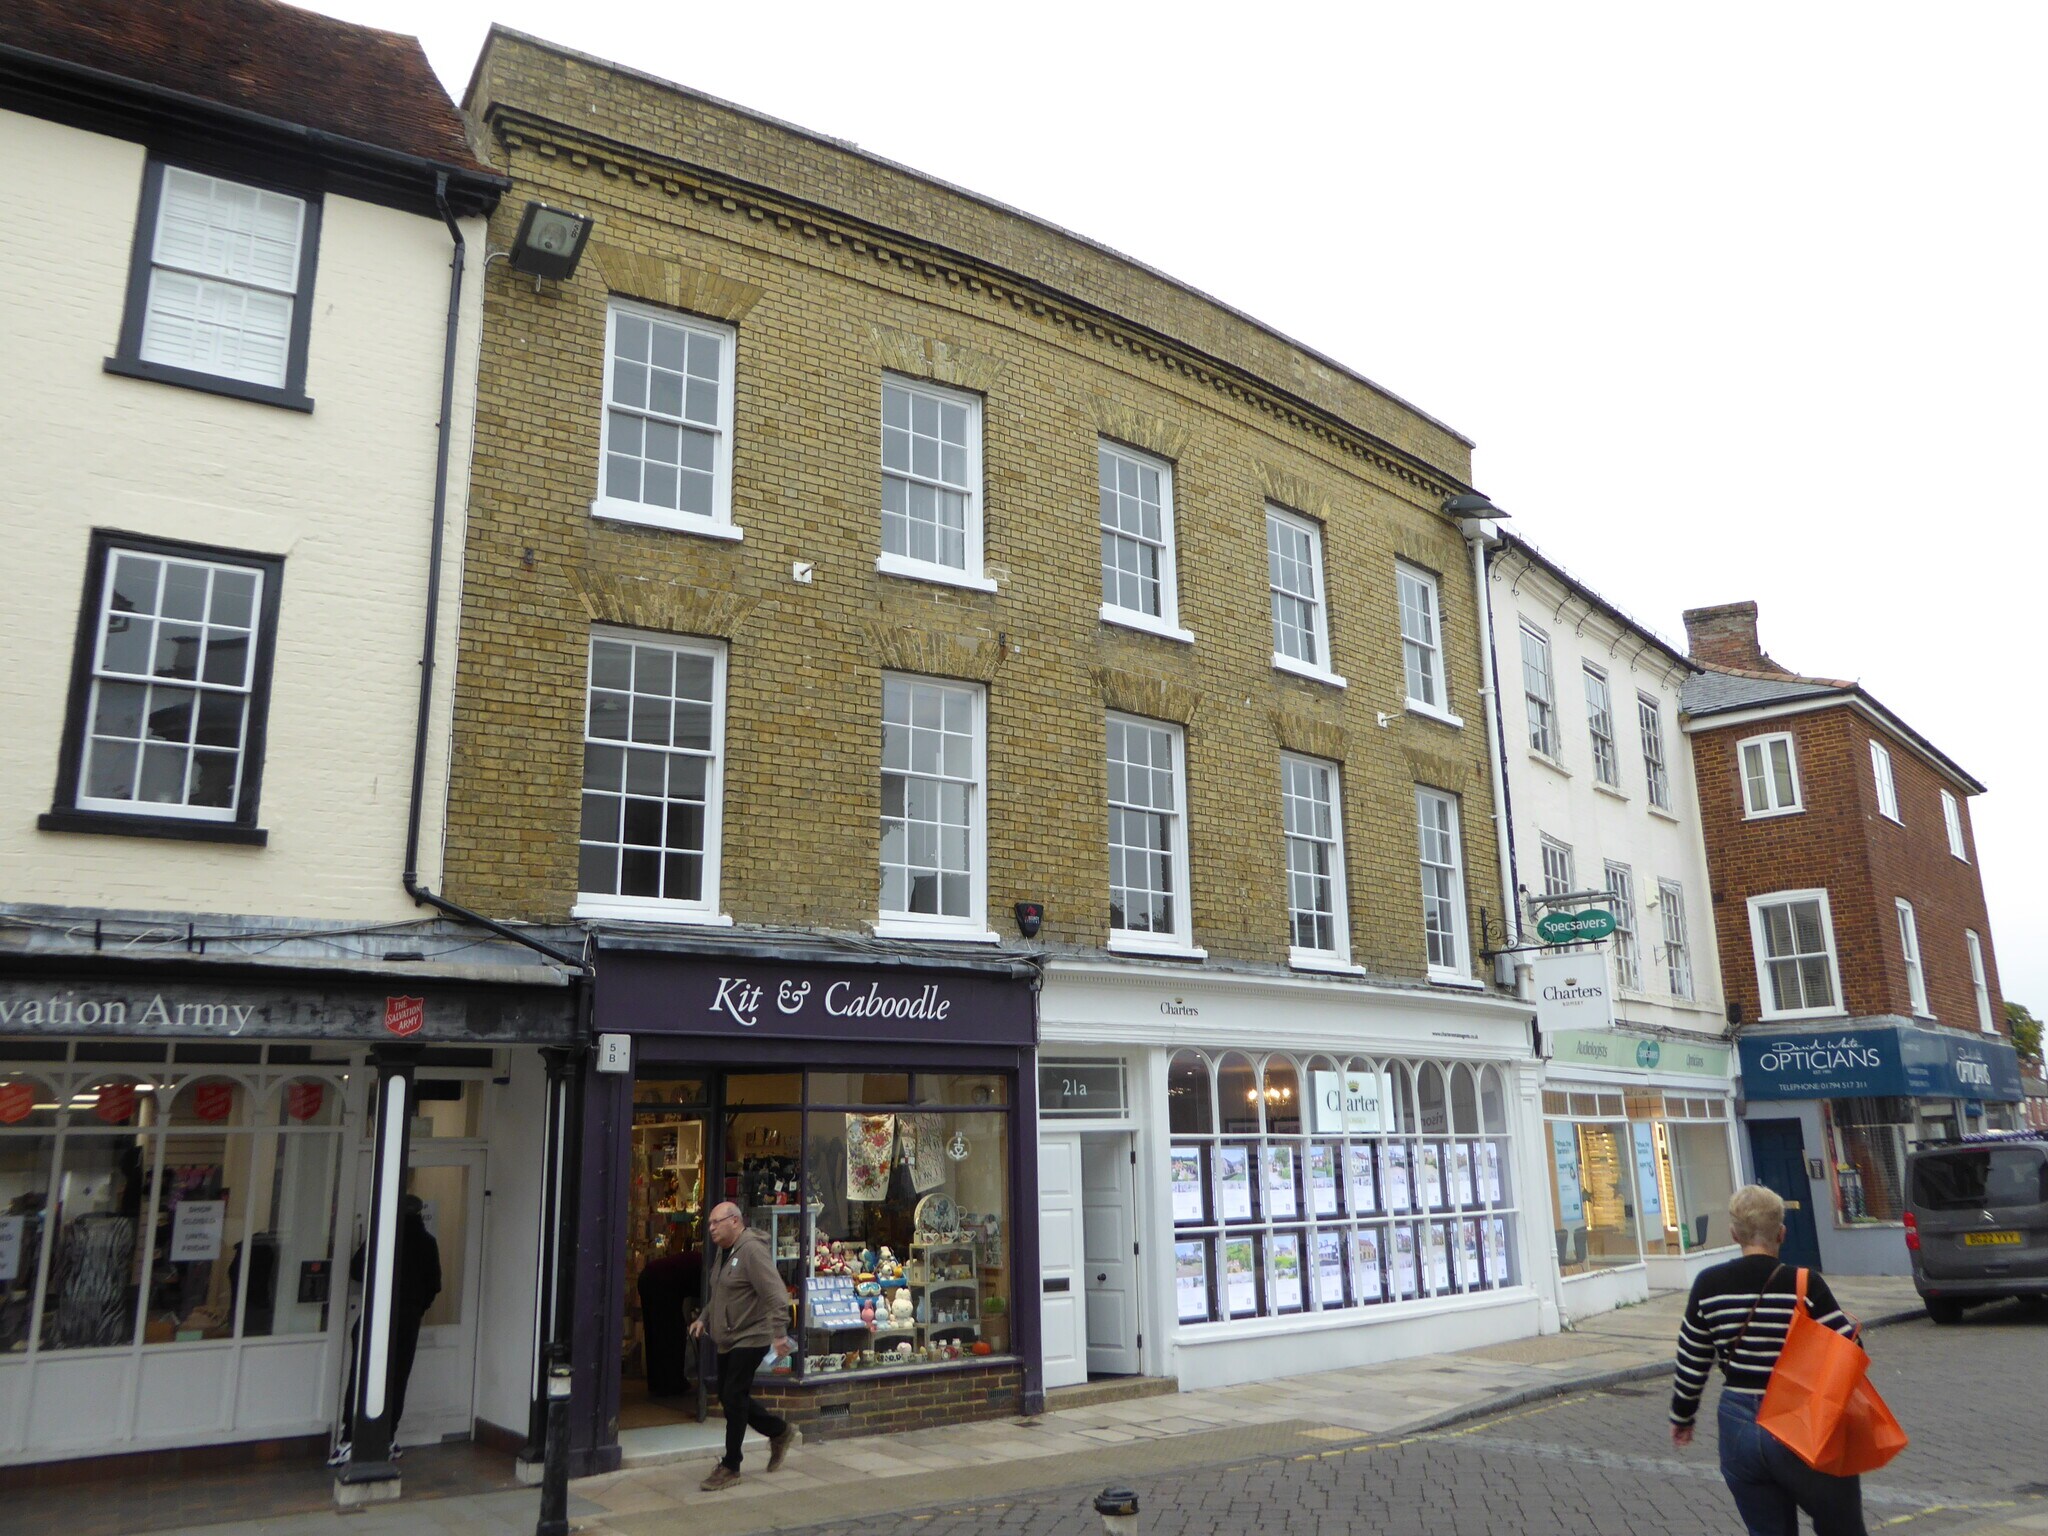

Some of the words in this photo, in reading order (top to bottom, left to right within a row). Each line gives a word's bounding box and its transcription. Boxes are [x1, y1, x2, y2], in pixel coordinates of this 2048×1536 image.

[1544, 918, 1607, 933] Specsavers
[1543, 986, 1602, 1001] Charters
[395, 1000, 408, 1010] THE
[709, 977, 764, 1026] Kit
[777, 980, 811, 1014] &
[825, 981, 950, 1020] Caboodle
[1160, 1001, 1199, 1016] Charters
[0, 990, 127, 1025] vation
[138, 993, 254, 1036] Army
[387, 1003, 420, 1025] SALVATION
[398, 1014, 419, 1030] ARMY
[610, 1043, 617, 1052] 5
[1576, 1040, 1608, 1060] Audiologists
[609, 1053, 616, 1063] B
[1686, 1053, 1704, 1068] Opticians
[1760, 1048, 1880, 1071] OPTICIANS
[1062, 1078, 1088, 1096] 21a
